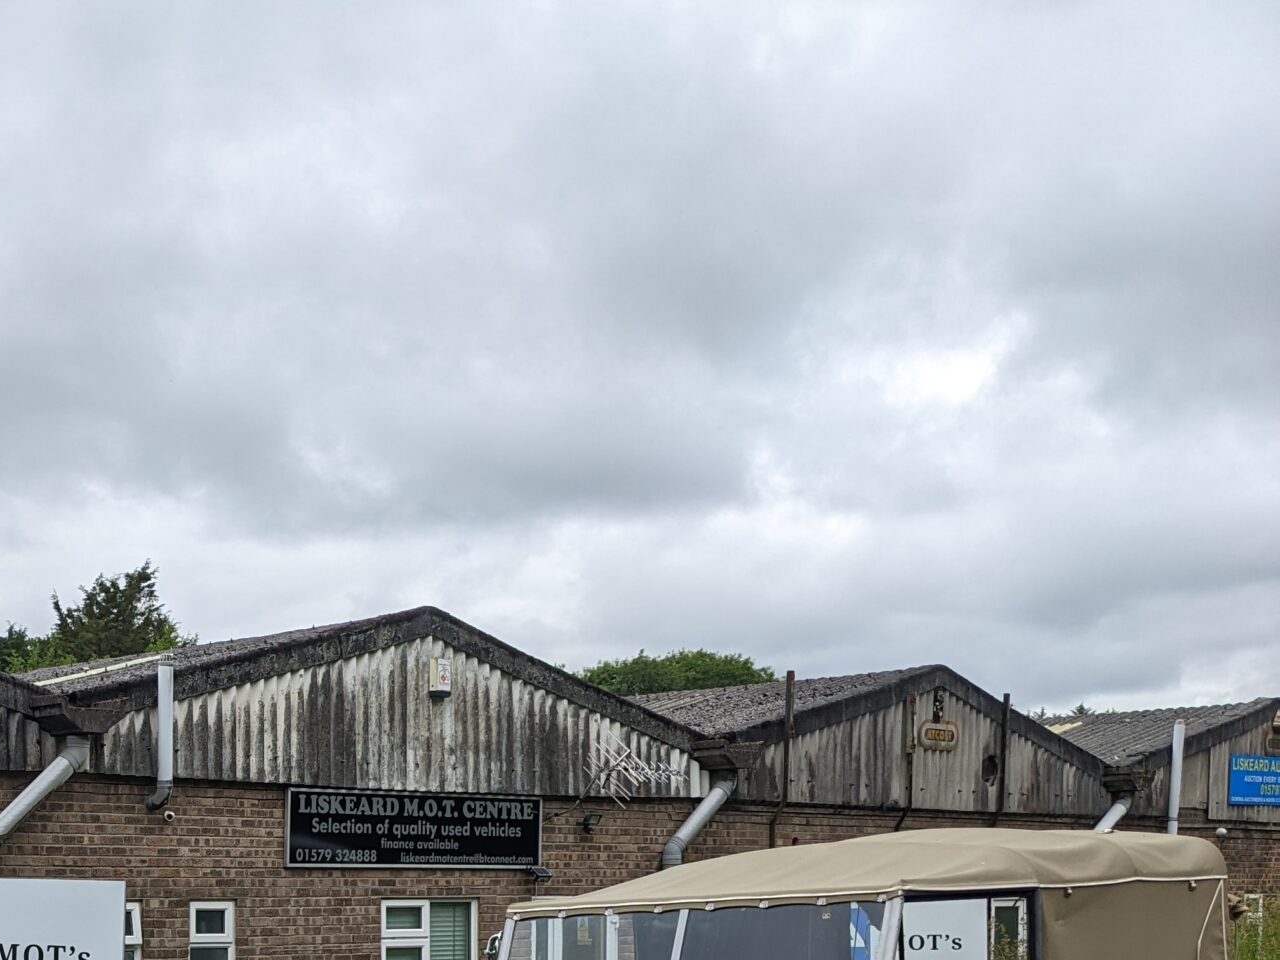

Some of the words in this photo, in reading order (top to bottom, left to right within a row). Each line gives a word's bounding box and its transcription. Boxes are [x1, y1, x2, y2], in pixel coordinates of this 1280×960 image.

[1232, 758, 1269, 772] LISKEARD
[297, 794, 399, 817] LISKEARD
[403, 798, 459, 818] M.O.T.
[462, 801, 535, 820] CENTRE
[311, 817, 372, 835] Selection
[376, 819, 390, 835] of
[392, 820, 438, 839] quality
[441, 822, 470, 837] used
[474, 823, 522, 838] vehicles
[380, 838, 415, 850] finance
[417, 838, 459, 850] available
[295, 848, 332, 862] 01579
[335, 849, 377, 863] 324888
[400, 852, 534, 865] liskeardmotcentre@btconnect.com
[908, 934, 962, 951] OT's
